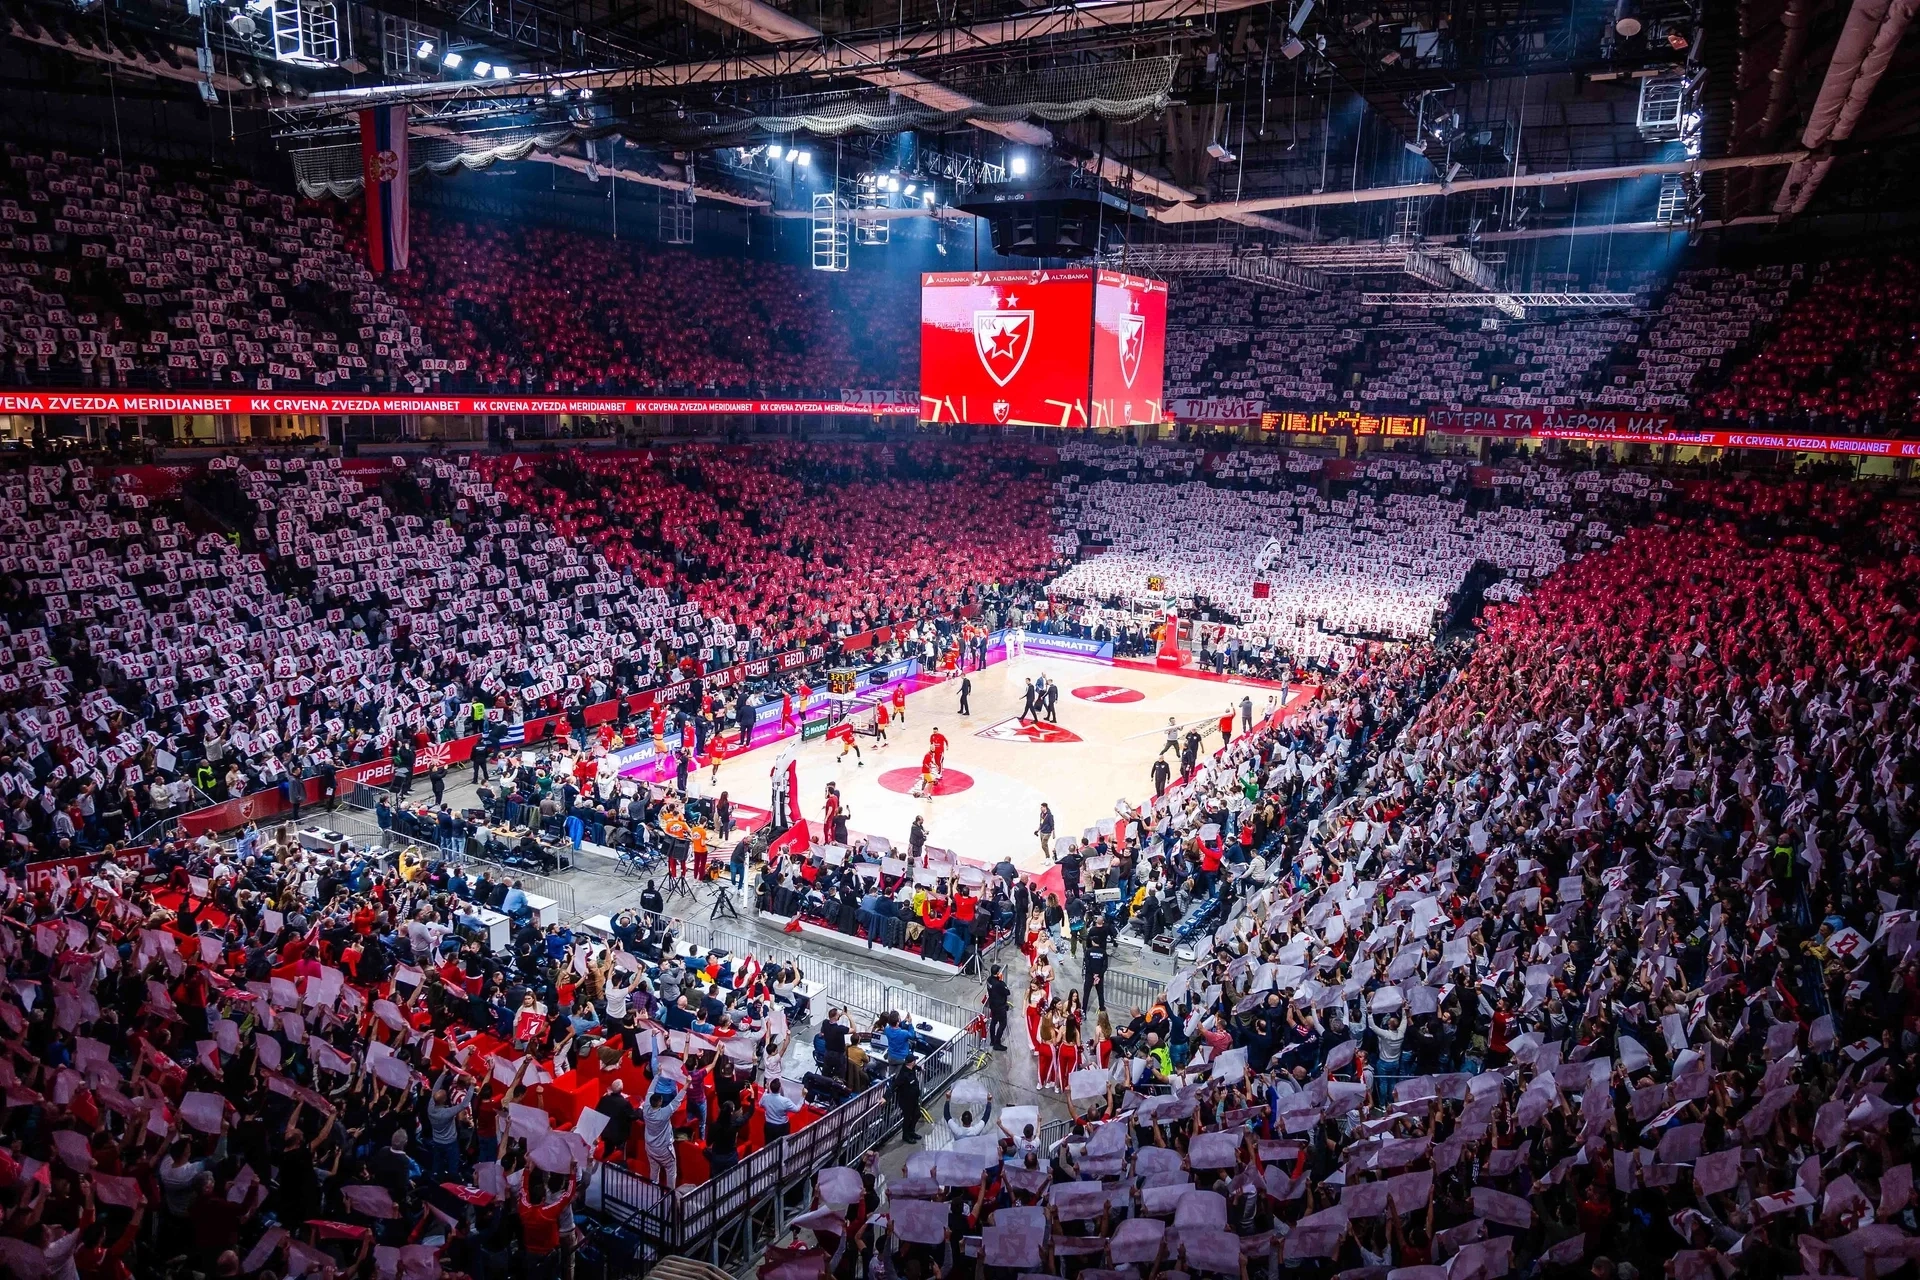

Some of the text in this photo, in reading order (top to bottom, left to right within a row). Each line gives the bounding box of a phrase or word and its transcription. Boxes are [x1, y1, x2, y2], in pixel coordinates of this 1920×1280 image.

[980, 319, 996, 330] KK
[0, 397, 232, 411] ENA ZVEZDA MERIDIANBET
[251, 399, 460, 411] KK CRVENA ZVEZDA MERIDIANBET
[473, 401, 627, 412] KK CRVENA ZVEZDA MERIDIANBET
[635, 402, 753, 412] KK CRVENA ZVEZDA MERIDIANBET
[760, 403, 769, 411] KK
[769, 403, 794, 411] CRVENA
[794, 403, 823, 412] ZVEZDA
[1728, 435, 1891, 453] KK CRVENA ZVEZDA MERIDIANBET
[1901, 444, 1915, 455] KK
[832, 685, 844, 693] 24
